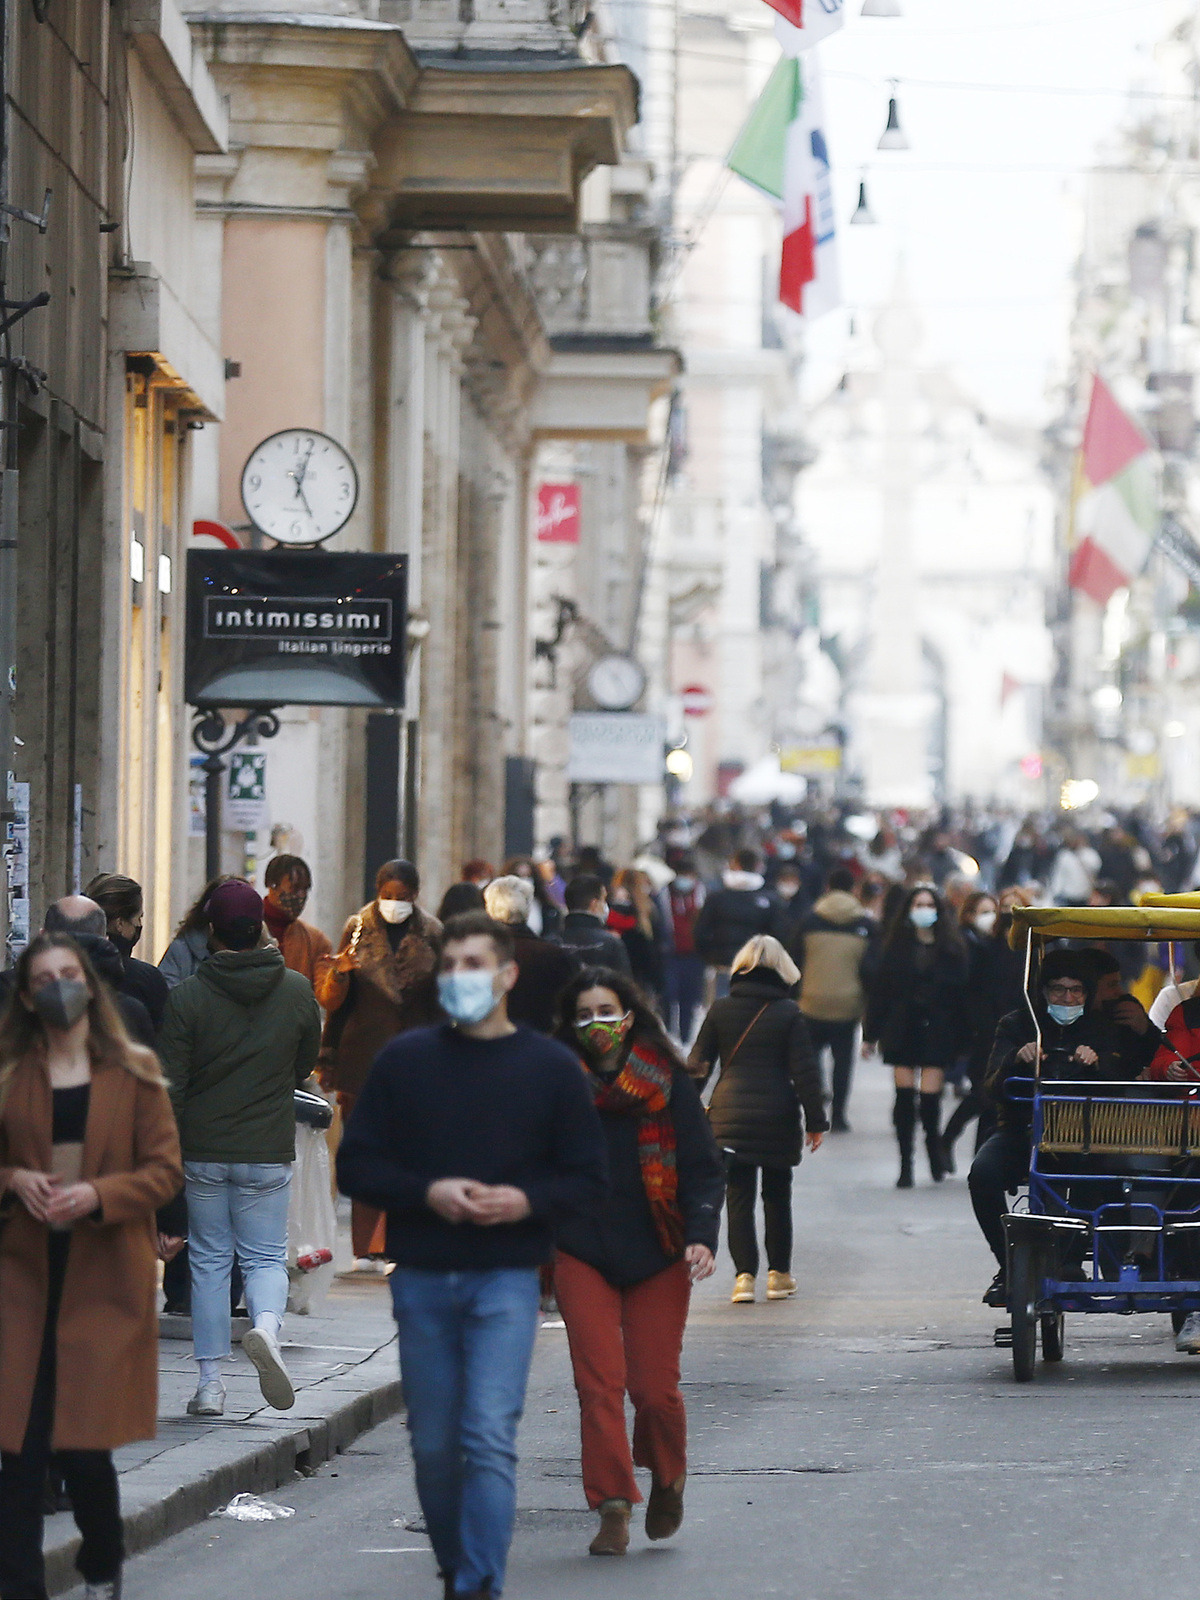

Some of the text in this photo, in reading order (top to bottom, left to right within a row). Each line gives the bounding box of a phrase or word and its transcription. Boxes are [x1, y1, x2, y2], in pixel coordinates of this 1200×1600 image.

[293, 437, 316, 456] 12
[215, 608, 381, 630] intimissimi
[278, 640, 391, 658] Italian lingerie
